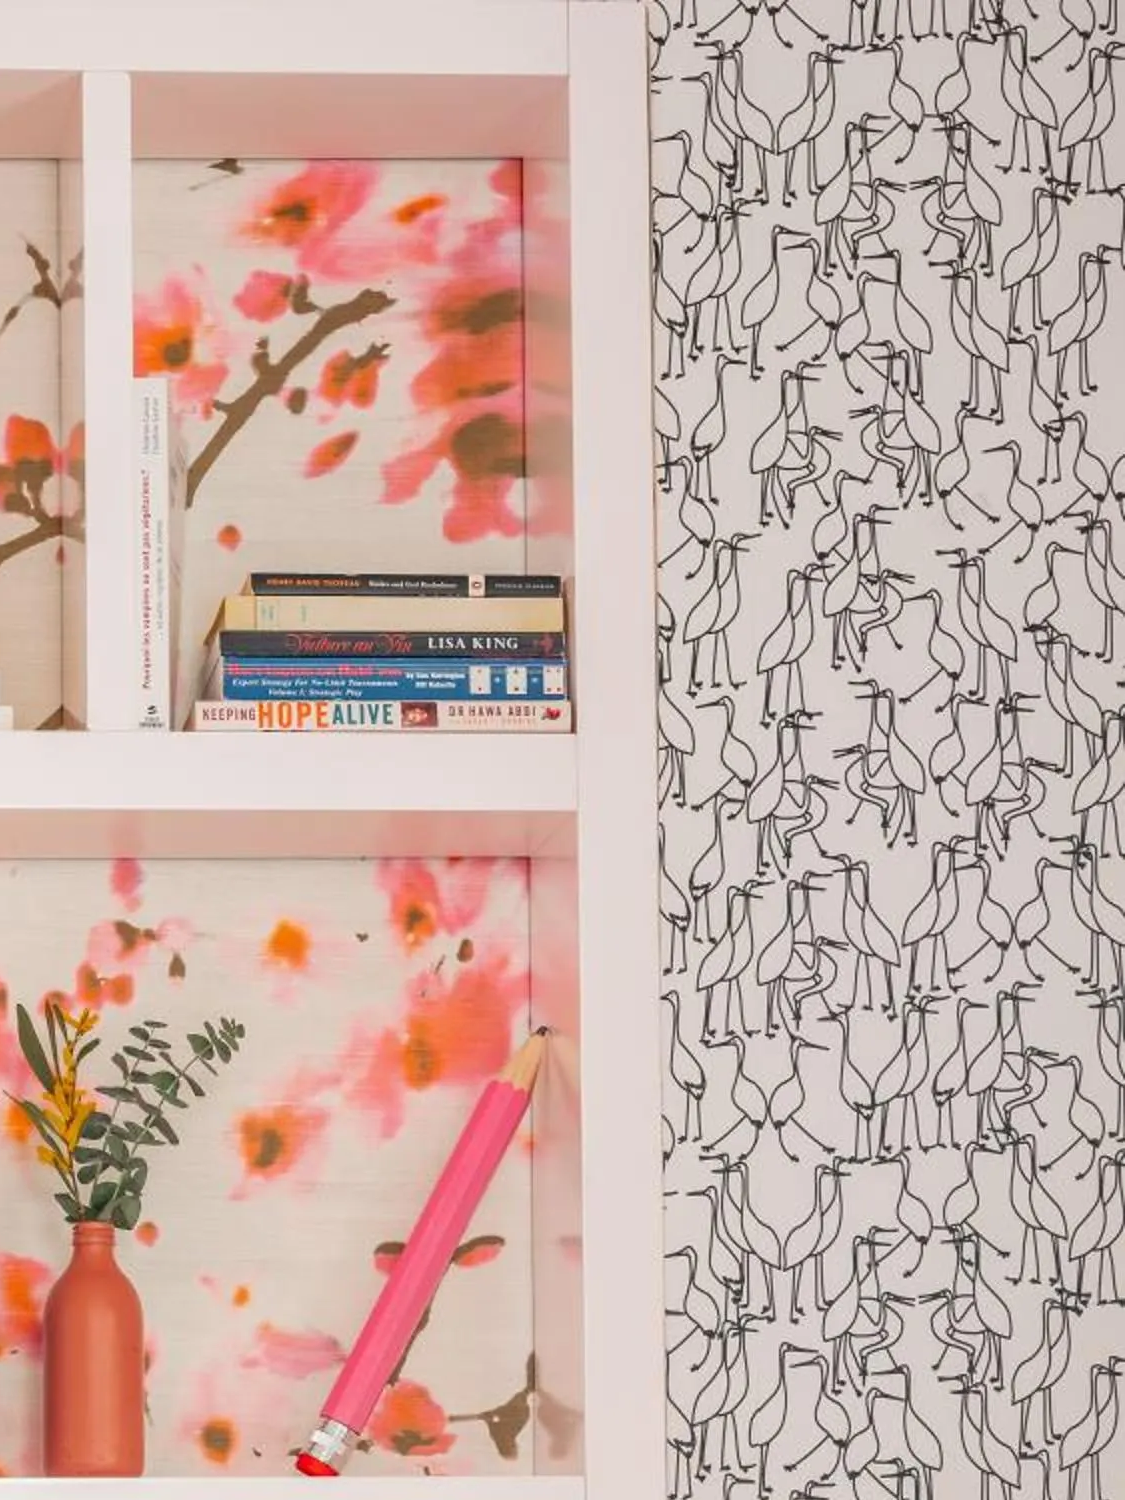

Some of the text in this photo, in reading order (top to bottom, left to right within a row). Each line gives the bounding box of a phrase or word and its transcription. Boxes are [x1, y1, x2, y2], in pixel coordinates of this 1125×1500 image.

[428, 637, 518, 650] LISA KING
[202, 701, 394, 728] KEEPING HOPE ALIVE
[468, 705, 503, 717] HAWA
[507, 705, 538, 717] ABDI
